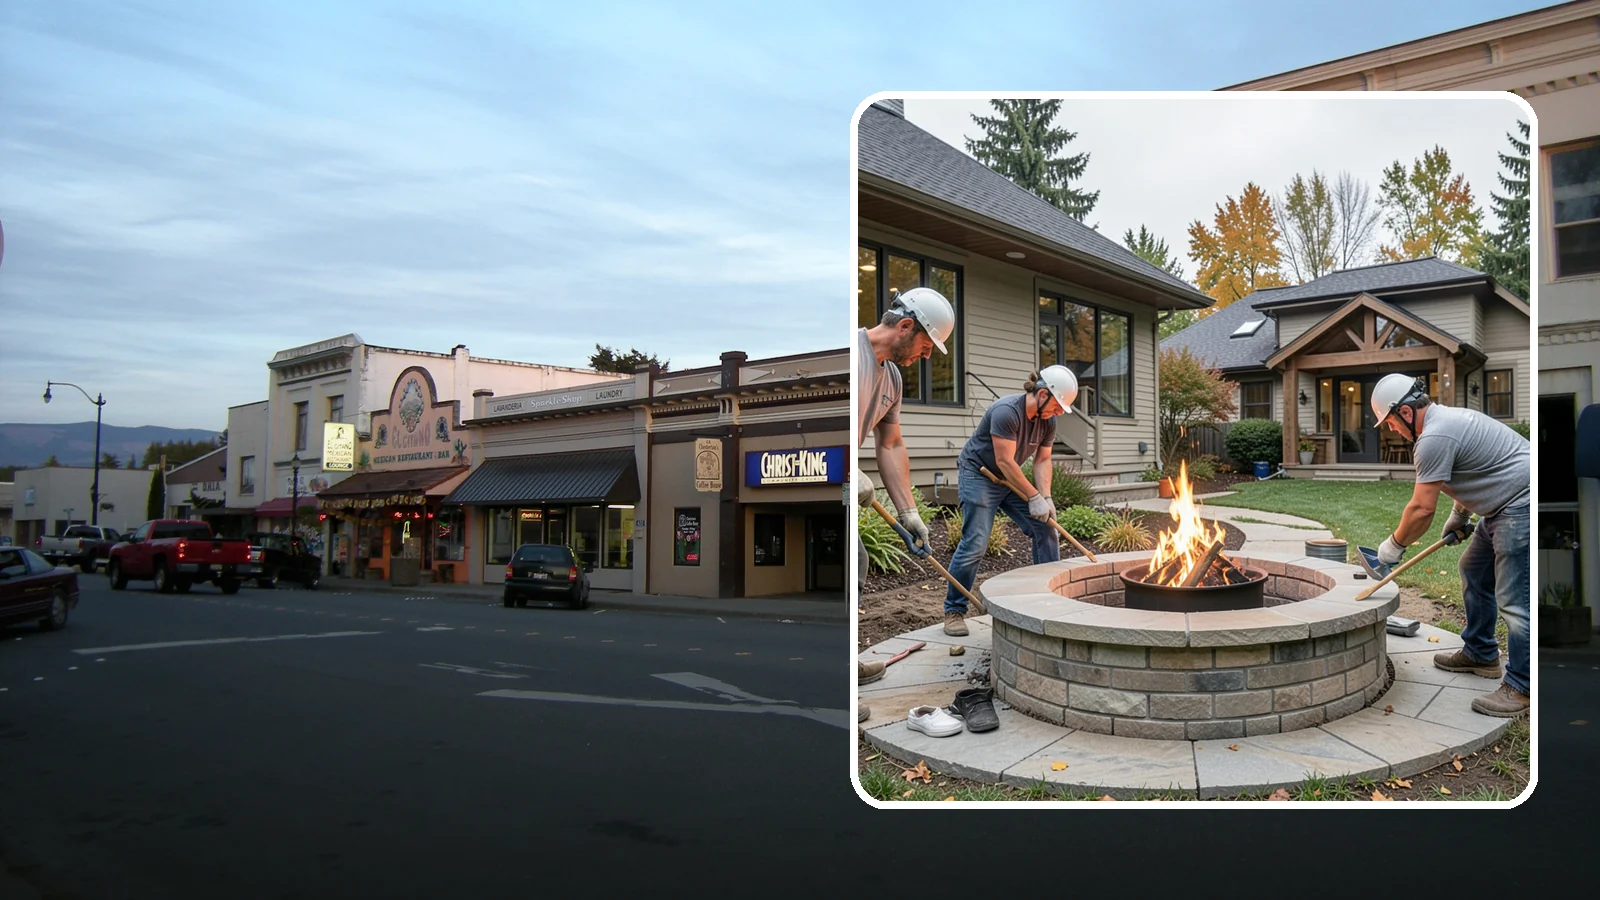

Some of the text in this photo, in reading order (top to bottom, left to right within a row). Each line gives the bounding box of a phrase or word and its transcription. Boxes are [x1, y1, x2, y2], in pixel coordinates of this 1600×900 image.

[595, 389, 623, 400] LAUNDRY
[494, 403, 523, 413] LAVANDERIA
[531, 395, 582, 409] Sparkle Shop
[373, 454, 396, 464] MEXICAN
[397, 451, 433, 463] RESTAURANT
[437, 450, 450, 459] BAR
[800, 450, 827, 475] KING
[697, 480, 721, 488] Coffee House
